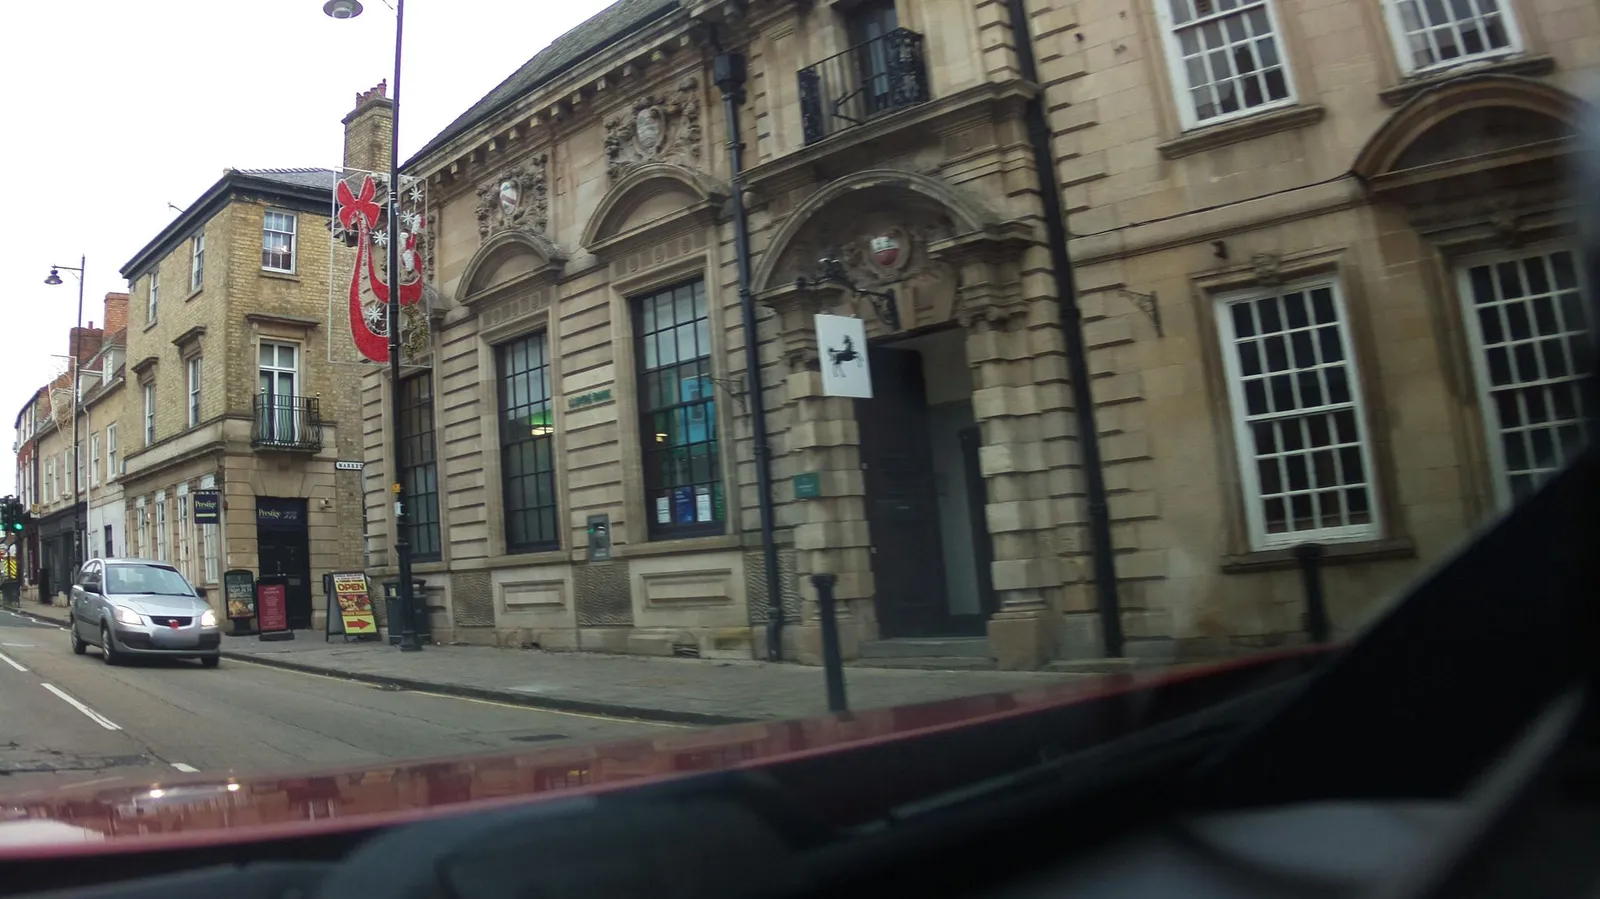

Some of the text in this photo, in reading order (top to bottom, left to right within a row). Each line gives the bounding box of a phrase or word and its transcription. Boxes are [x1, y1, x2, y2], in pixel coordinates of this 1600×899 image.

[195, 500, 217, 509] Prestige
[258, 508, 282, 519] Prestige
[337, 583, 366, 592] OPEN
